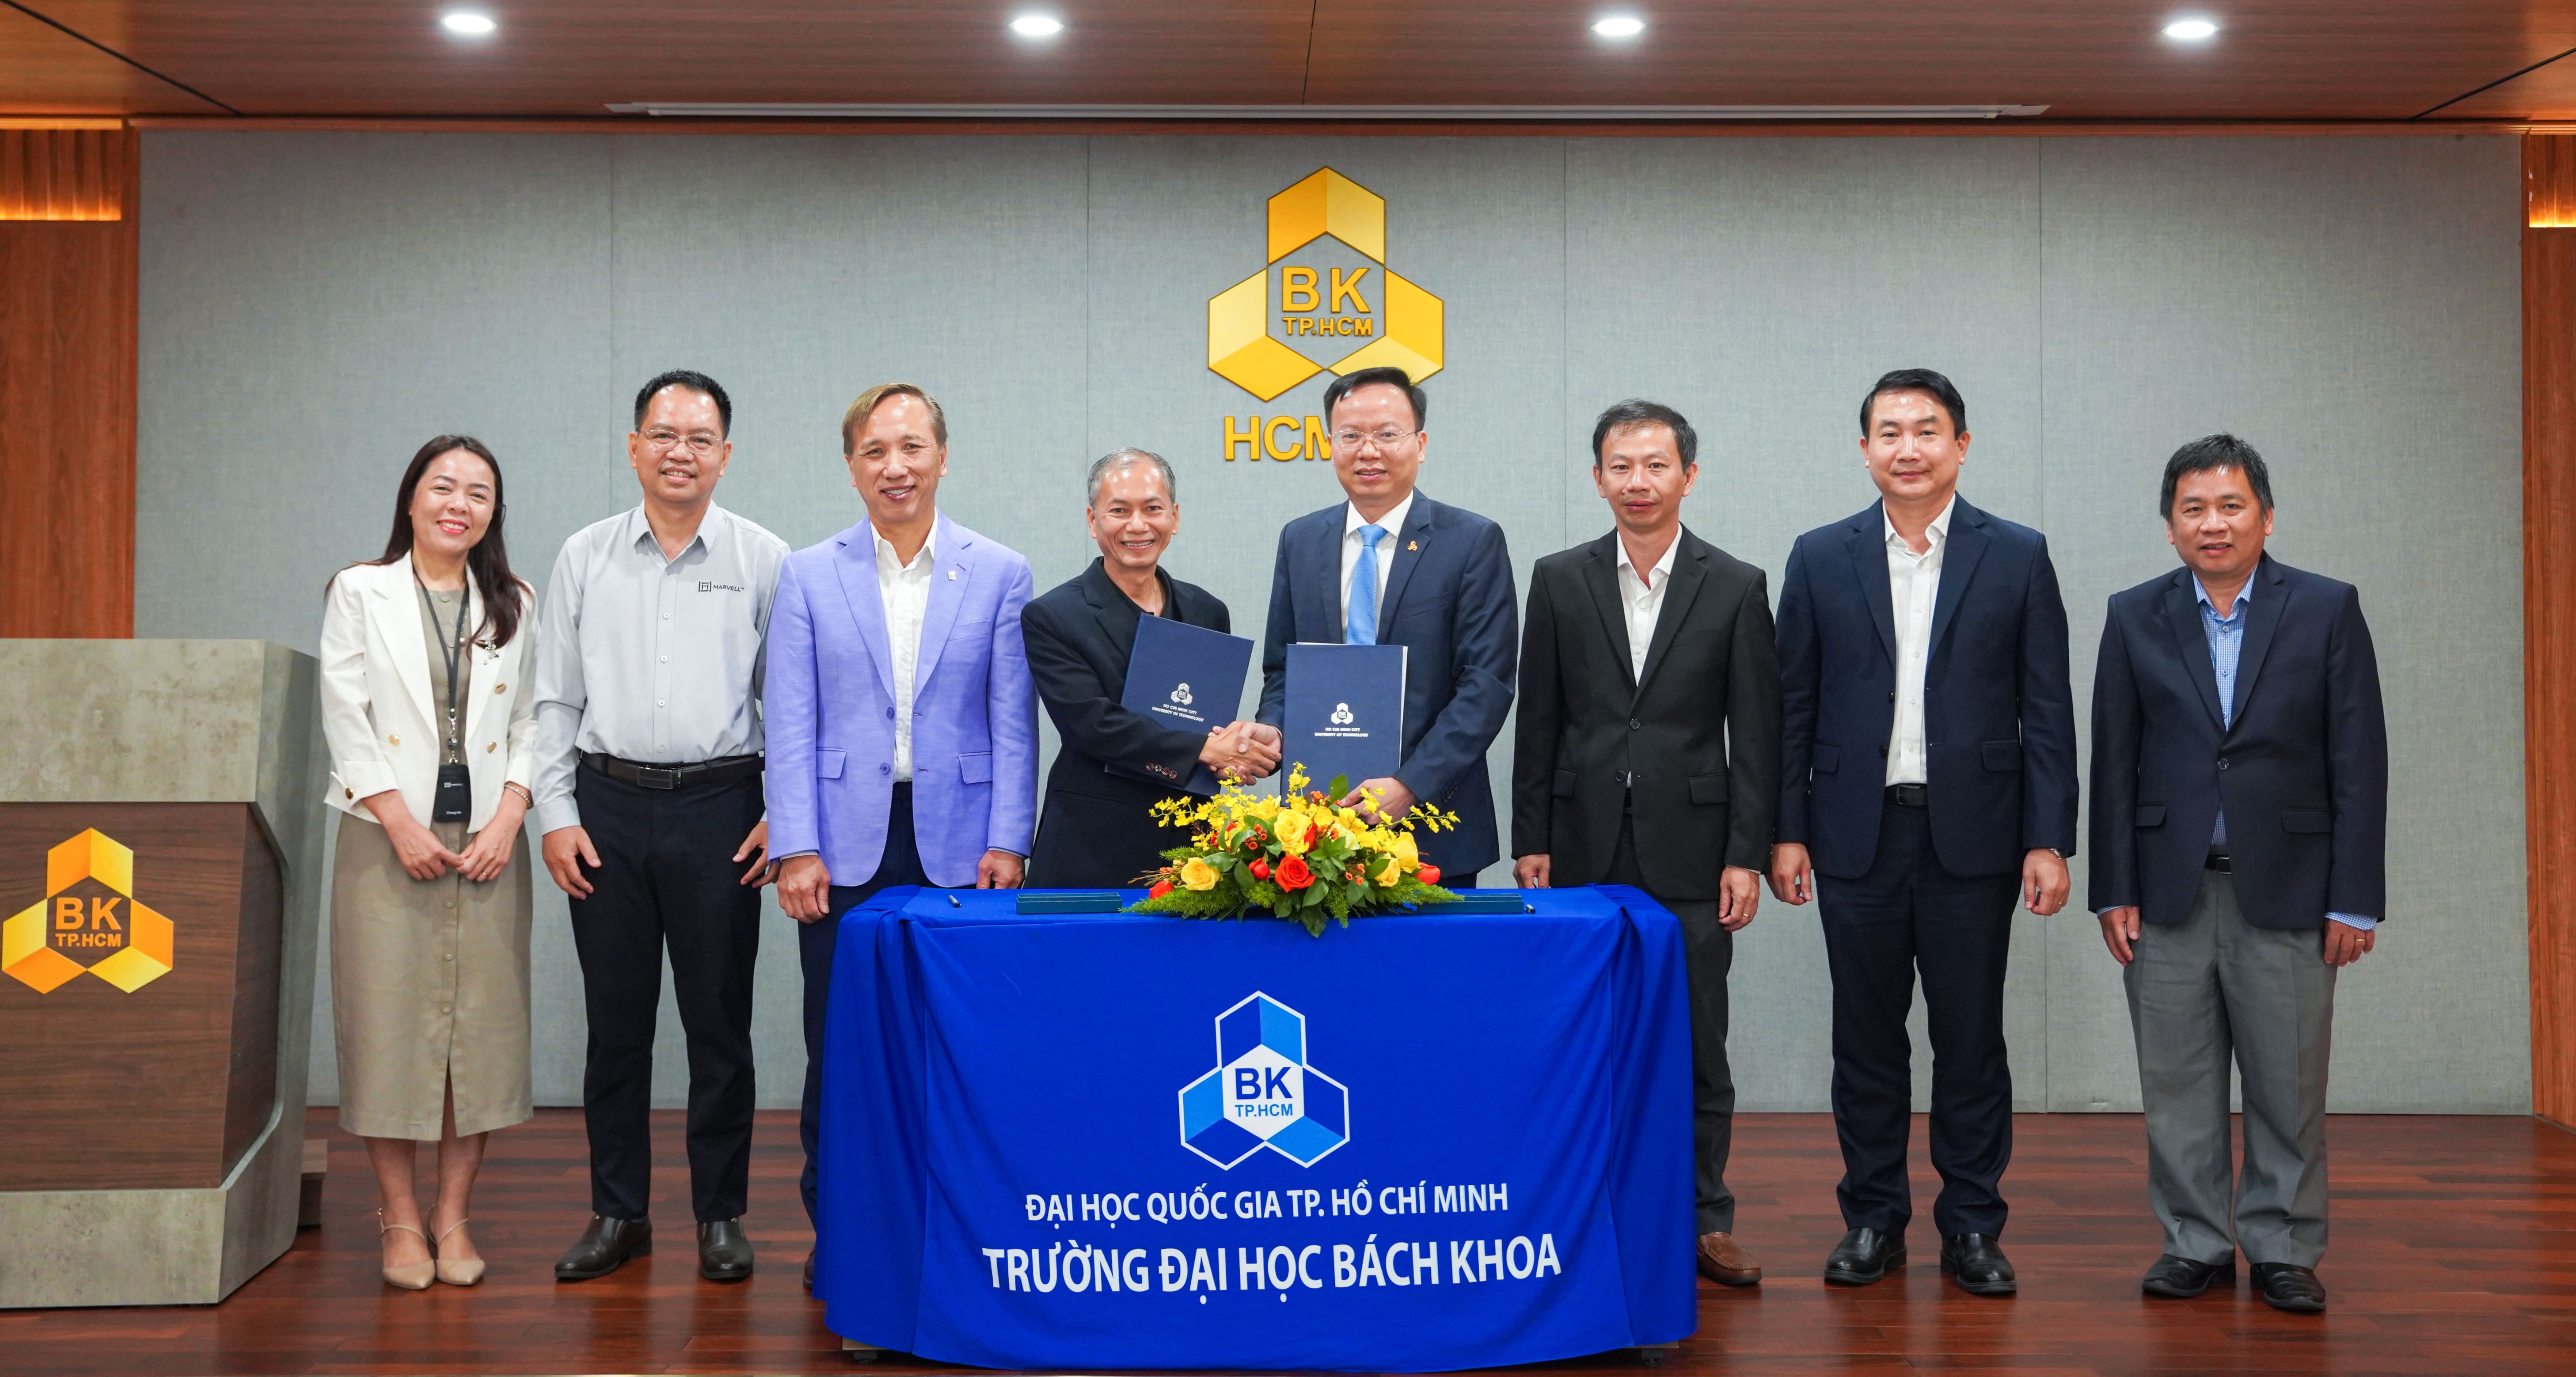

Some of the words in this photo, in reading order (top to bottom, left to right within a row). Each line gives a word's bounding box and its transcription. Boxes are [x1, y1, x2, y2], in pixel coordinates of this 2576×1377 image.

[1282, 266, 1371, 313] BK
[1282, 317, 1372, 336] TP.HCM
[1179, 713, 1204, 722] TECHNOLOGY
[55, 897, 122, 930] BK
[55, 933, 122, 947] TP.HCM
[1235, 1066, 1293, 1100] BK
[1235, 1103, 1293, 1117] TP.HCM
[1025, 1194, 1074, 1229] ĐẠI
[1081, 1193, 1140, 1229] HỌC
[1147, 1183, 1227, 1224] QUỐC
[1234, 1190, 1283, 1219] GIA
[1287, 1189, 1325, 1217] TP.
[1331, 1179, 1372, 1216] HỒ
[1379, 1180, 1426, 1215] CHÍ
[1434, 1183, 1508, 1213] MINH
[982, 1239, 1150, 1293] TRƯỜNG
[1158, 1247, 1227, 1305] ĐẠI
[1239, 1244, 1323, 1303] HỌC
[1333, 1234, 1439, 1288] BÁCH
[1450, 1233, 1562, 1284] KHOA
